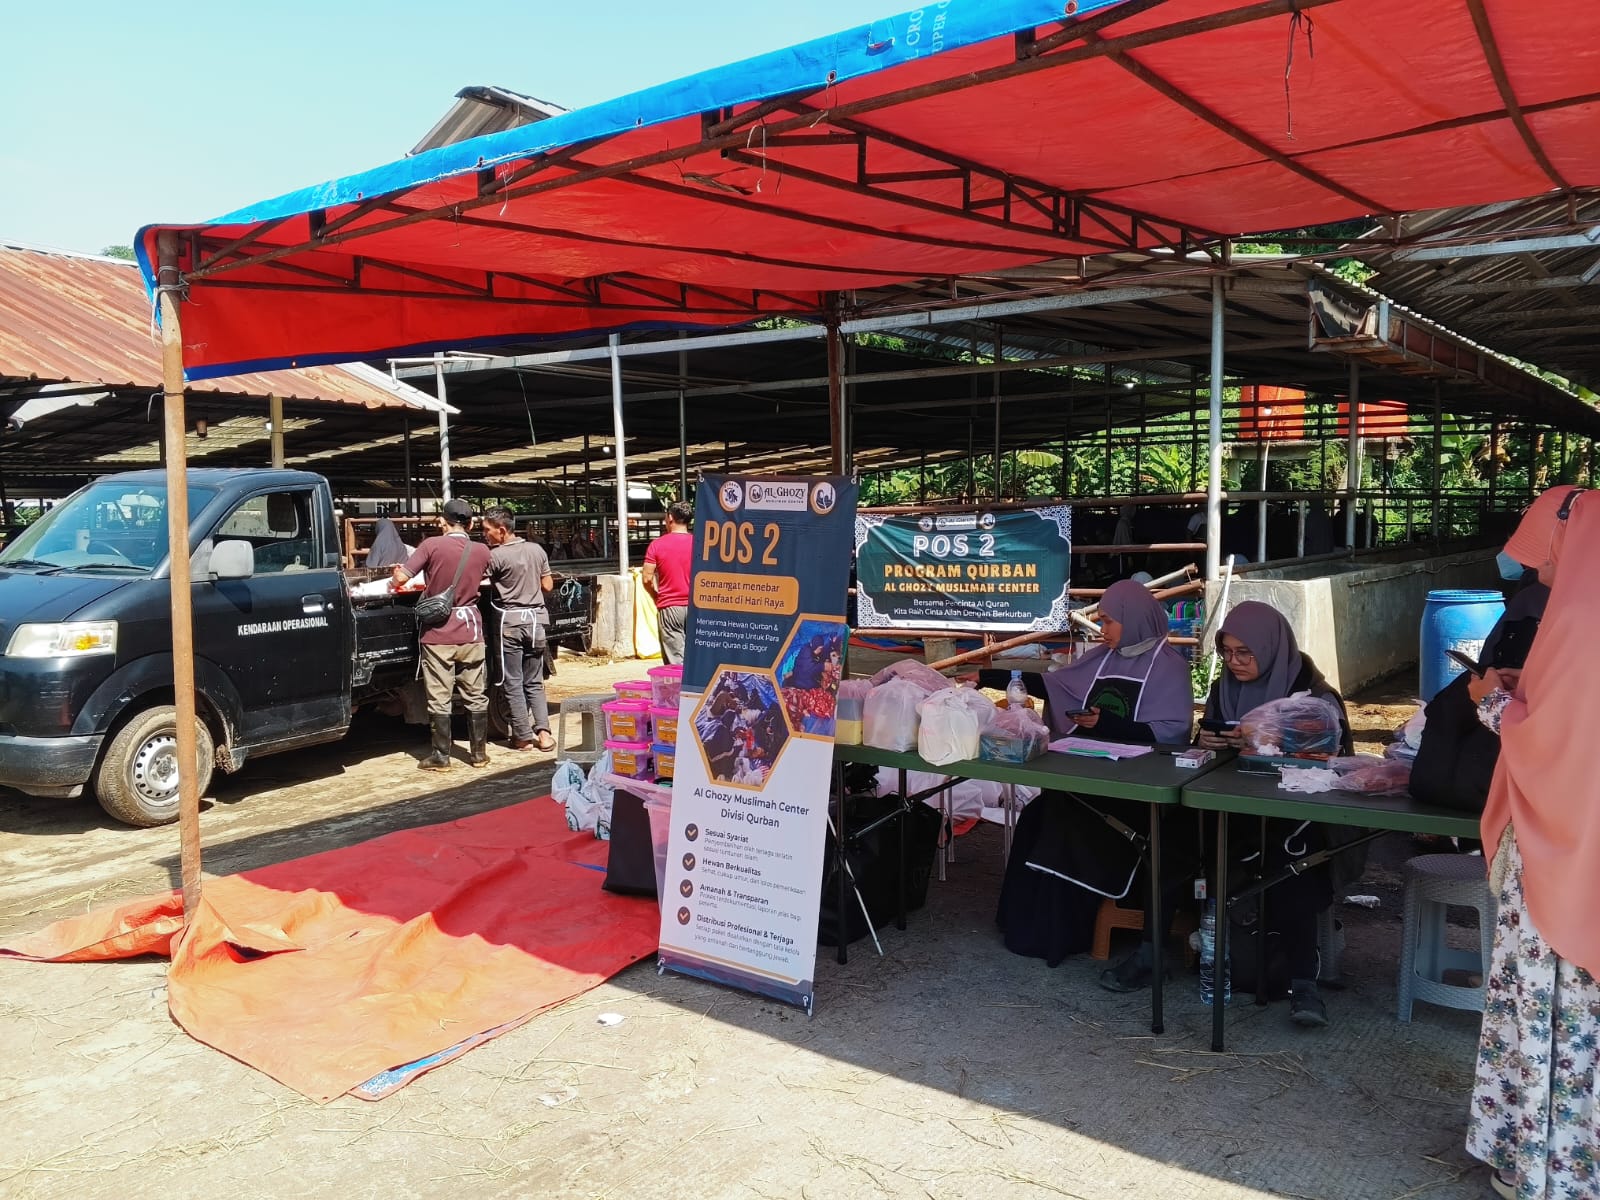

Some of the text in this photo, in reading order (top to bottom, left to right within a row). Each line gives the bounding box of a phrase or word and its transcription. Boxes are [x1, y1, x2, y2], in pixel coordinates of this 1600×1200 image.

[764, 488, 777, 499] AL
[703, 520, 780, 565] POS 2
[914, 534, 994, 558] POS 2
[884, 564, 1036, 580] PROGRAM QURBAN
[700, 579, 780, 592] Semangat menebar
[884, 583, 896, 591] AL
[936, 584, 994, 593] MUSLIMAH
[999, 583, 1040, 593] CENTER
[700, 594, 784, 609] manfaat di Hari Raya
[914, 599, 943, 607] Bersama
[238, 617, 328, 636] KENDARAAN OPERASIONAL
[750, 623, 772, 631] Qurban
[695, 639, 721, 648] Pengajar
[750, 644, 767, 652] Bogor
[694, 788, 809, 816] Al Ghozy Muslimah Center
[721, 808, 780, 827] Divisi Qurban
[705, 829, 749, 843] Sesuai Syariat
[703, 858, 761, 876] Hewan Berkualitas
[700, 884, 725, 895] Amanah
[734, 891, 769, 904] Transparan
[697, 915, 726, 927] Distribusi
[727, 921, 762, 936] Profesional
[770, 933, 794, 944] Terjaga
